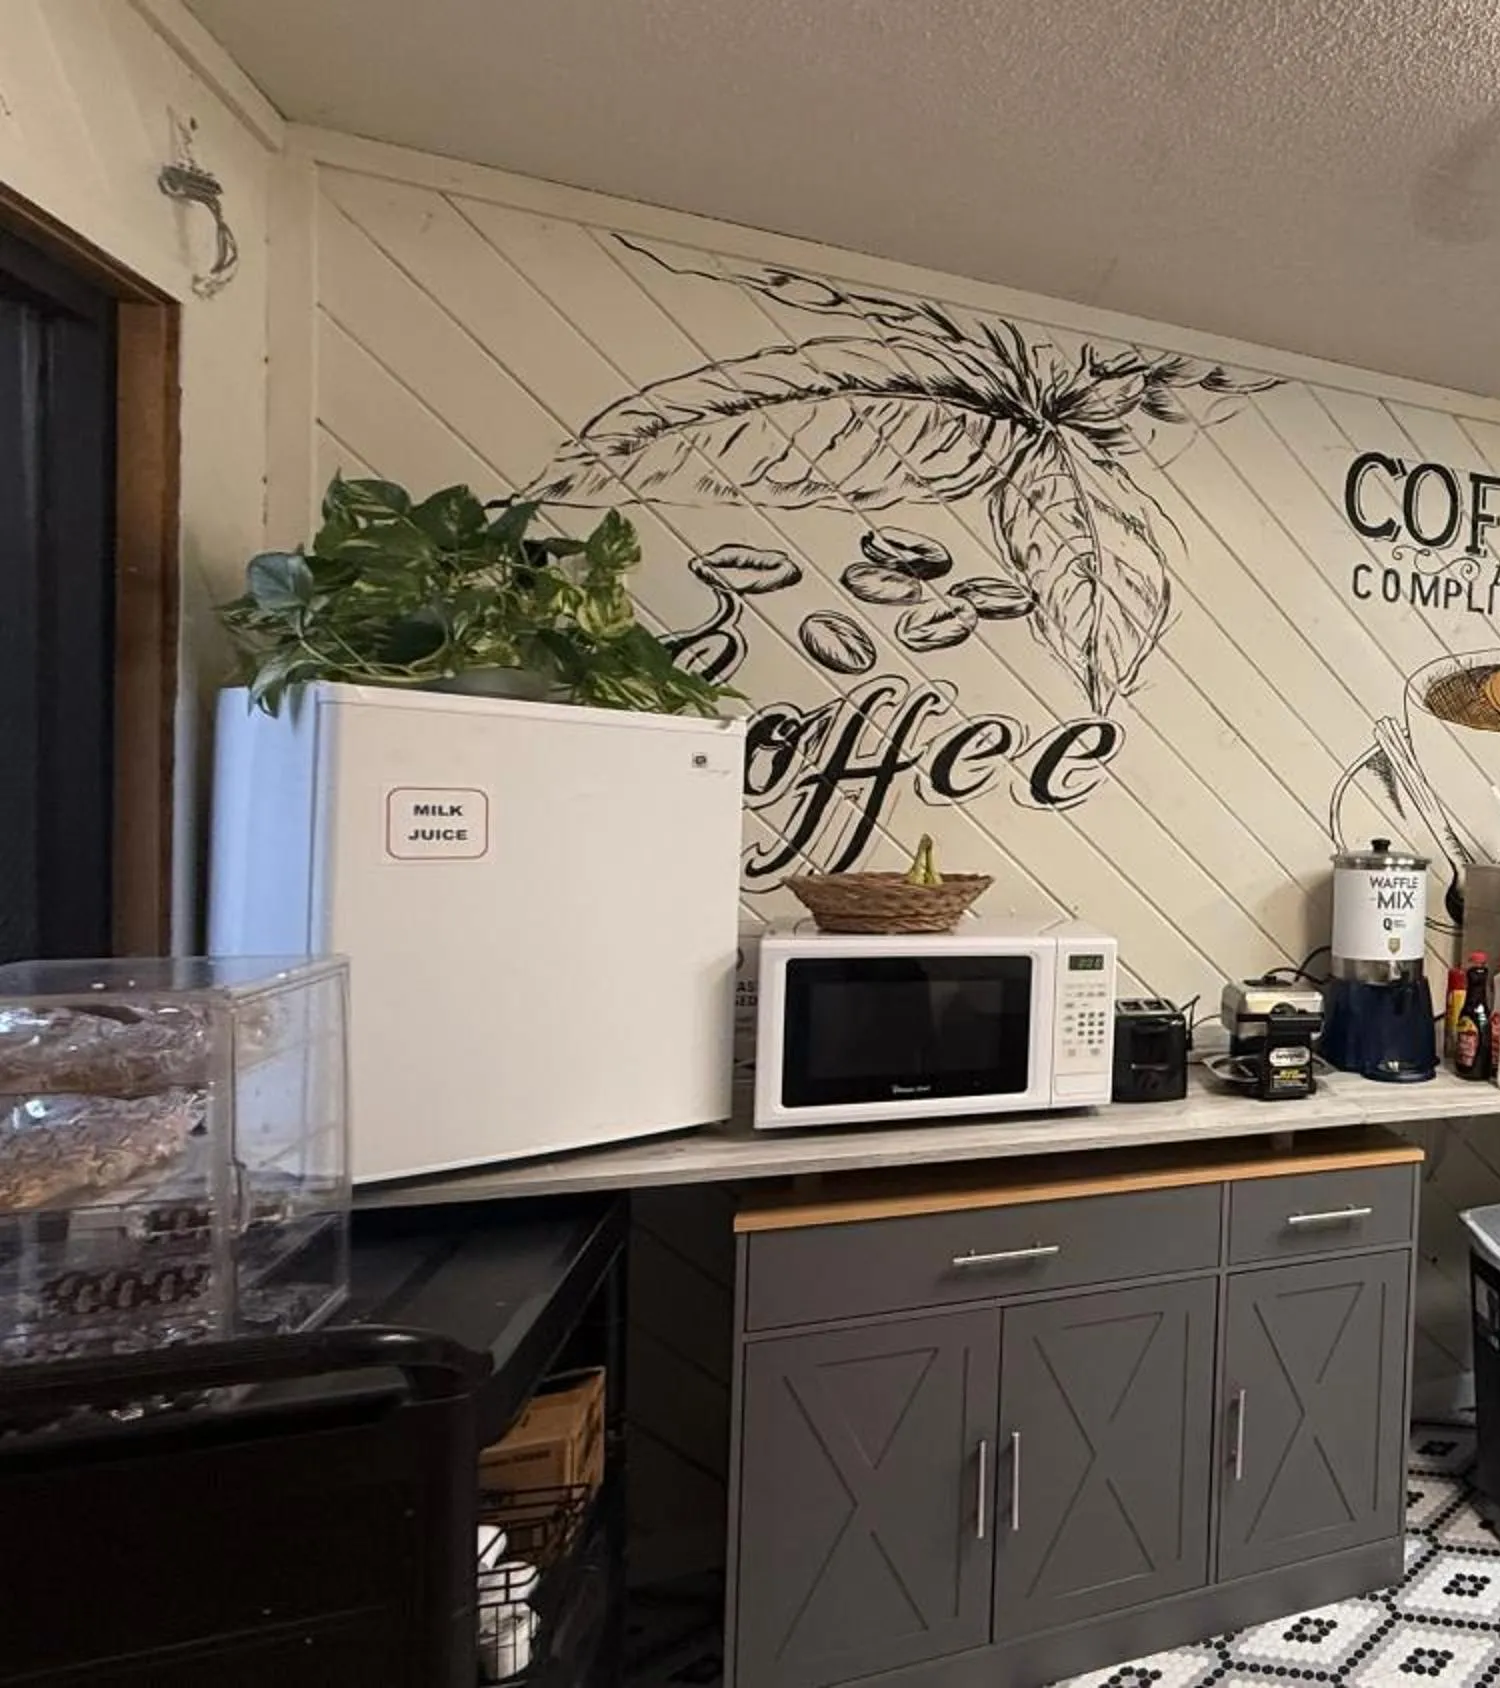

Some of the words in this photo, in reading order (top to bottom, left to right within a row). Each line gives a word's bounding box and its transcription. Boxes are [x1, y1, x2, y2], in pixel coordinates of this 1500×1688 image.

[413, 804, 464, 817] MILK
[408, 828, 469, 841] JUICE
[1370, 875, 1419, 889] WAFFLE
[1377, 891, 1415, 909] MIX
